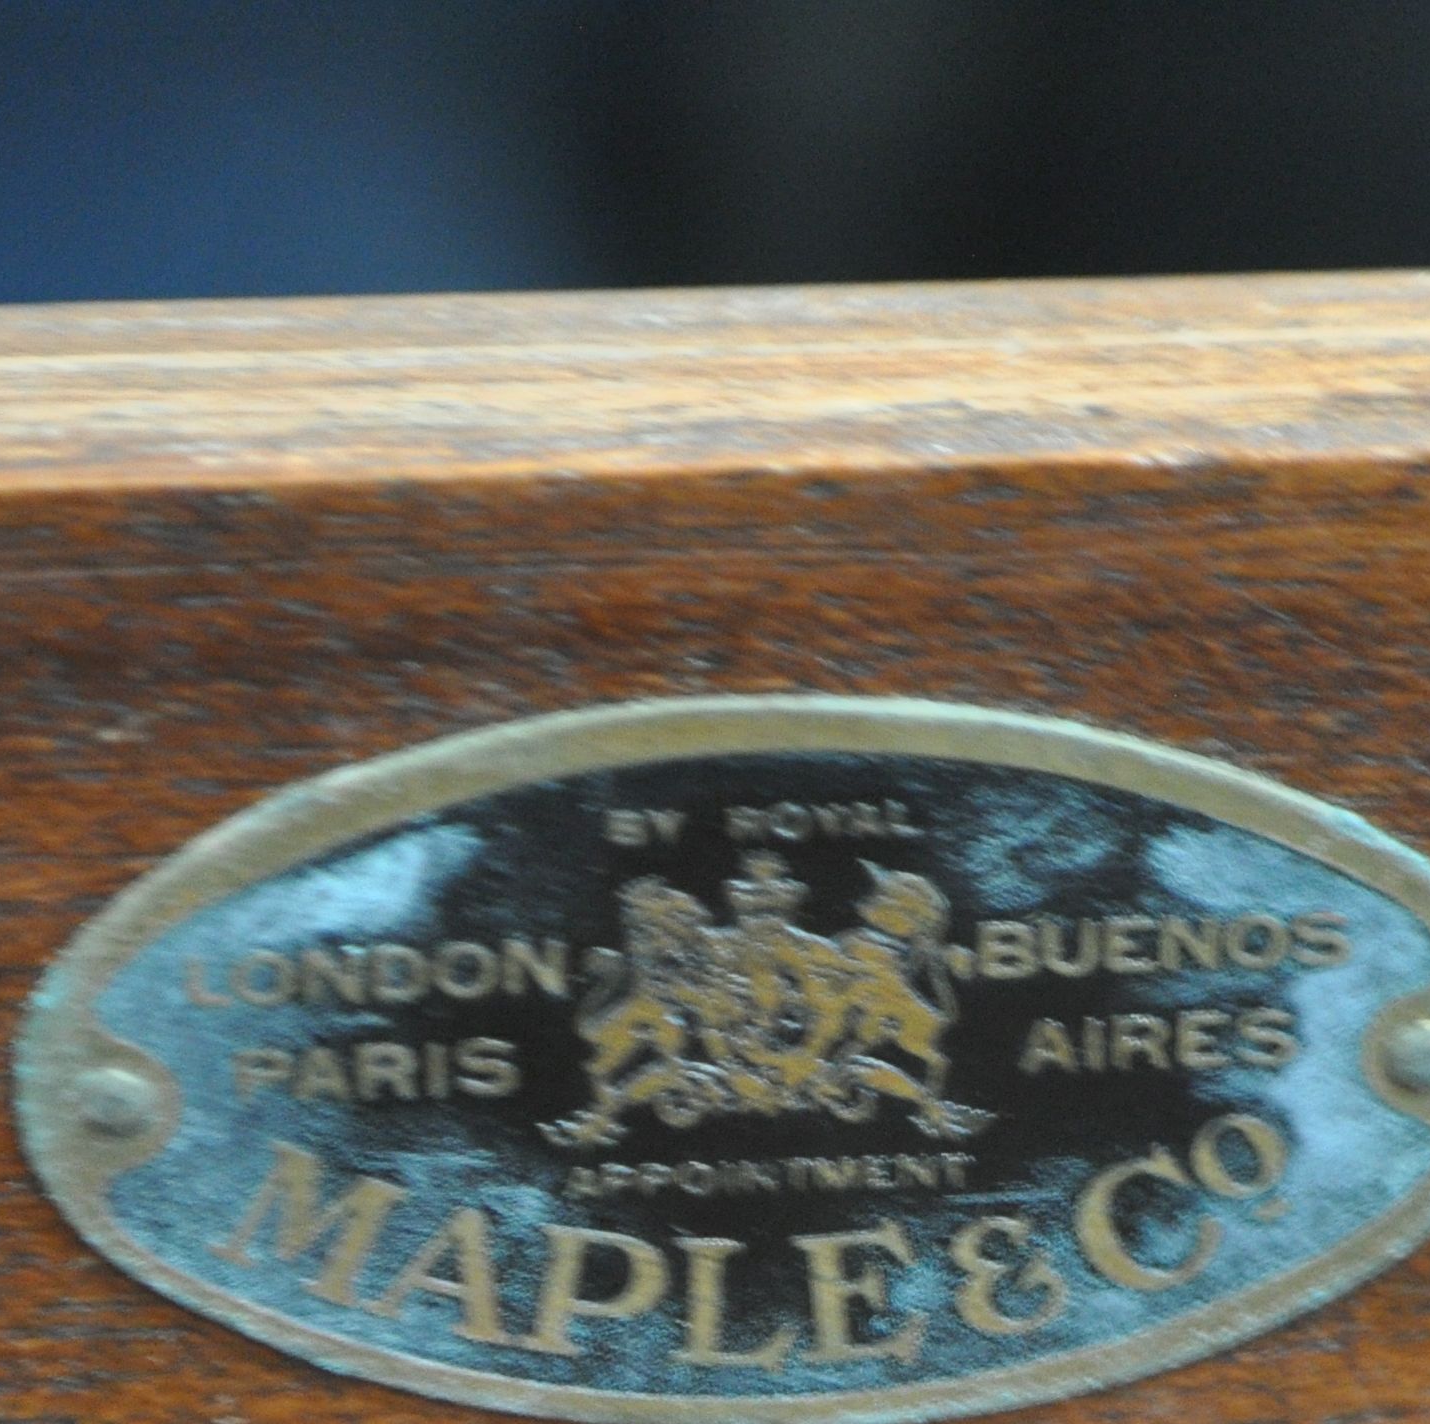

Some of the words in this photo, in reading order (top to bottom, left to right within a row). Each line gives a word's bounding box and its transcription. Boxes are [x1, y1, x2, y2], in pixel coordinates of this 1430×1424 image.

[723, 799, 923, 842] ROYAL
[182, 938, 570, 1008] LONDON
[975, 911, 1351, 980] BUENOS
[232, 1036, 521, 1100] PARIS
[1018, 1007, 1301, 1073] AIRES
